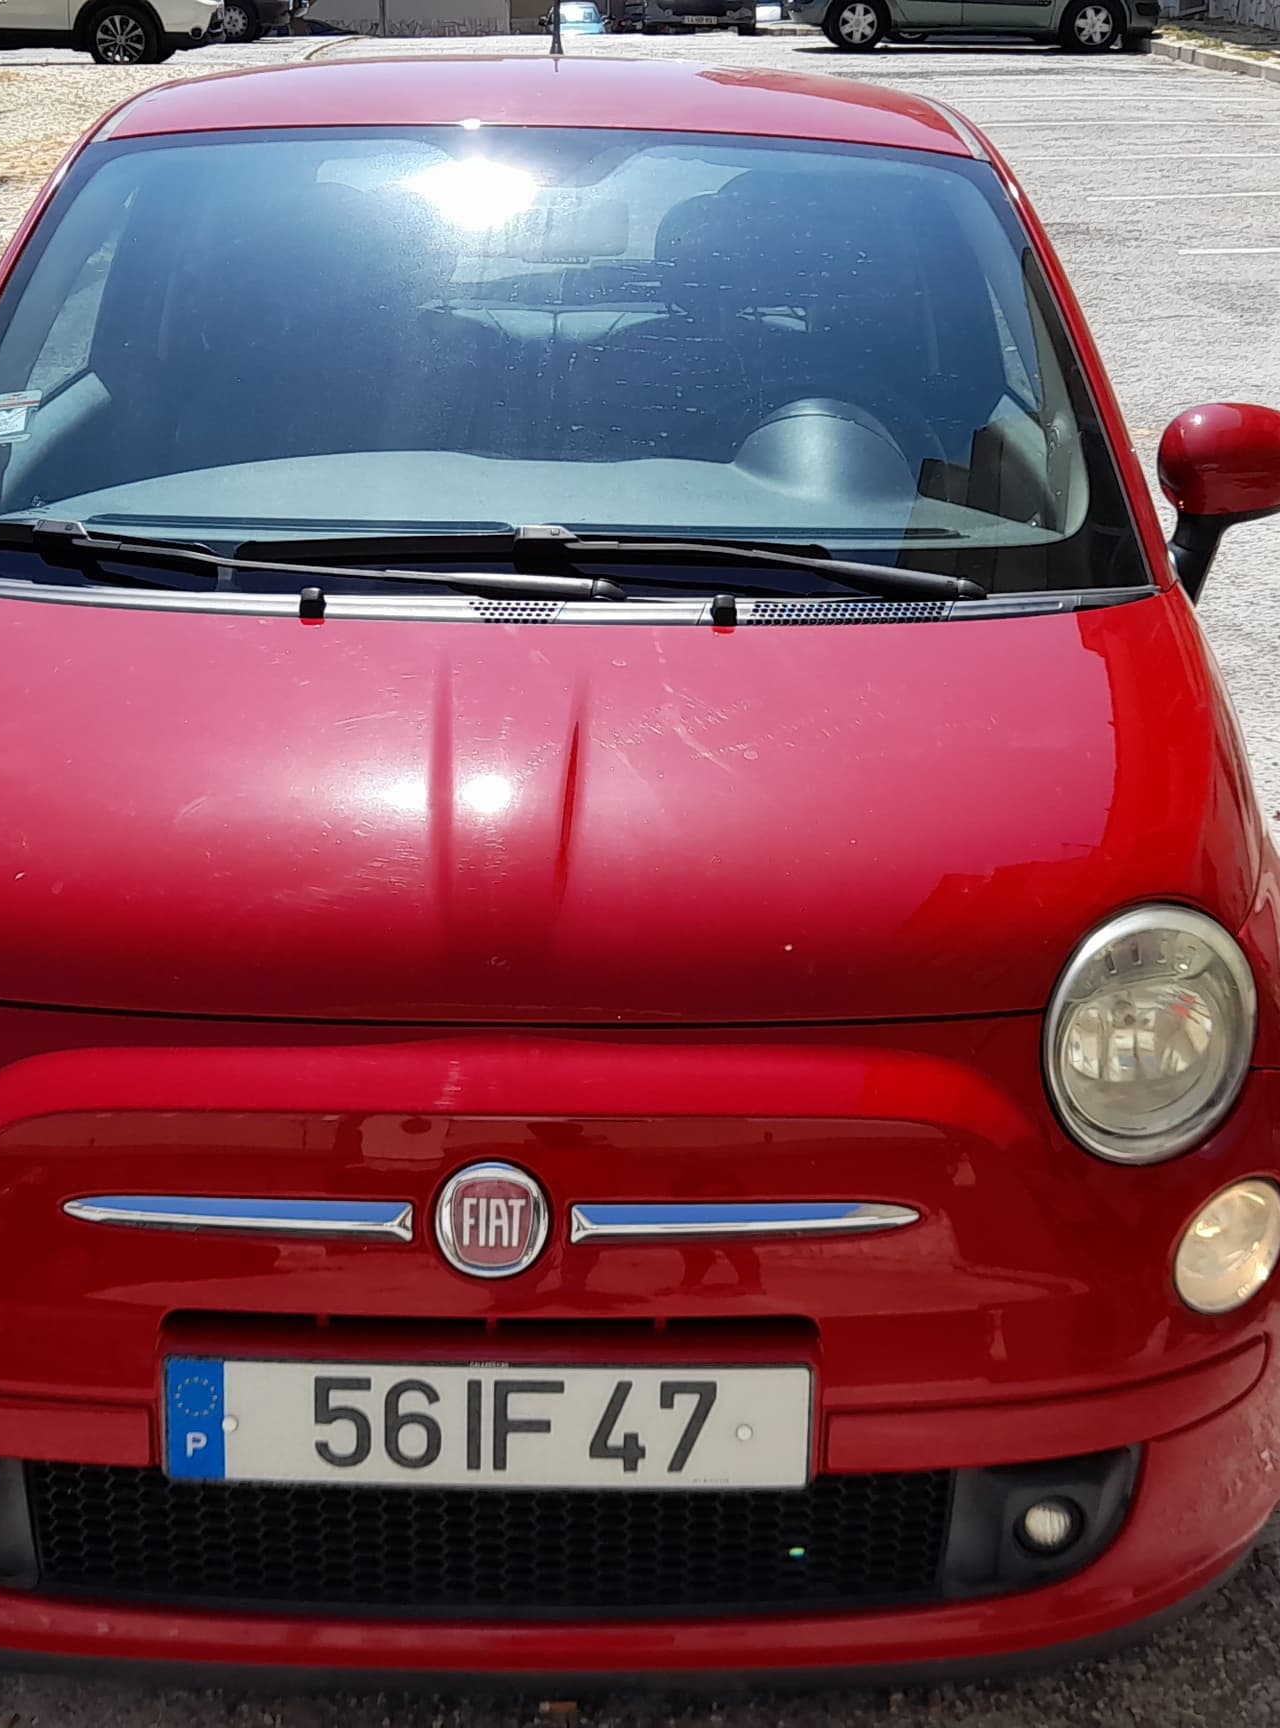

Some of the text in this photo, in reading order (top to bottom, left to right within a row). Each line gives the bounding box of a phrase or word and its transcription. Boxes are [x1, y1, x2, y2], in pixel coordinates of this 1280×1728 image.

[462, 1197, 526, 1247] FIAT
[185, 1432, 208, 1457] P
[313, 1375, 718, 1473] 56 IF 47
